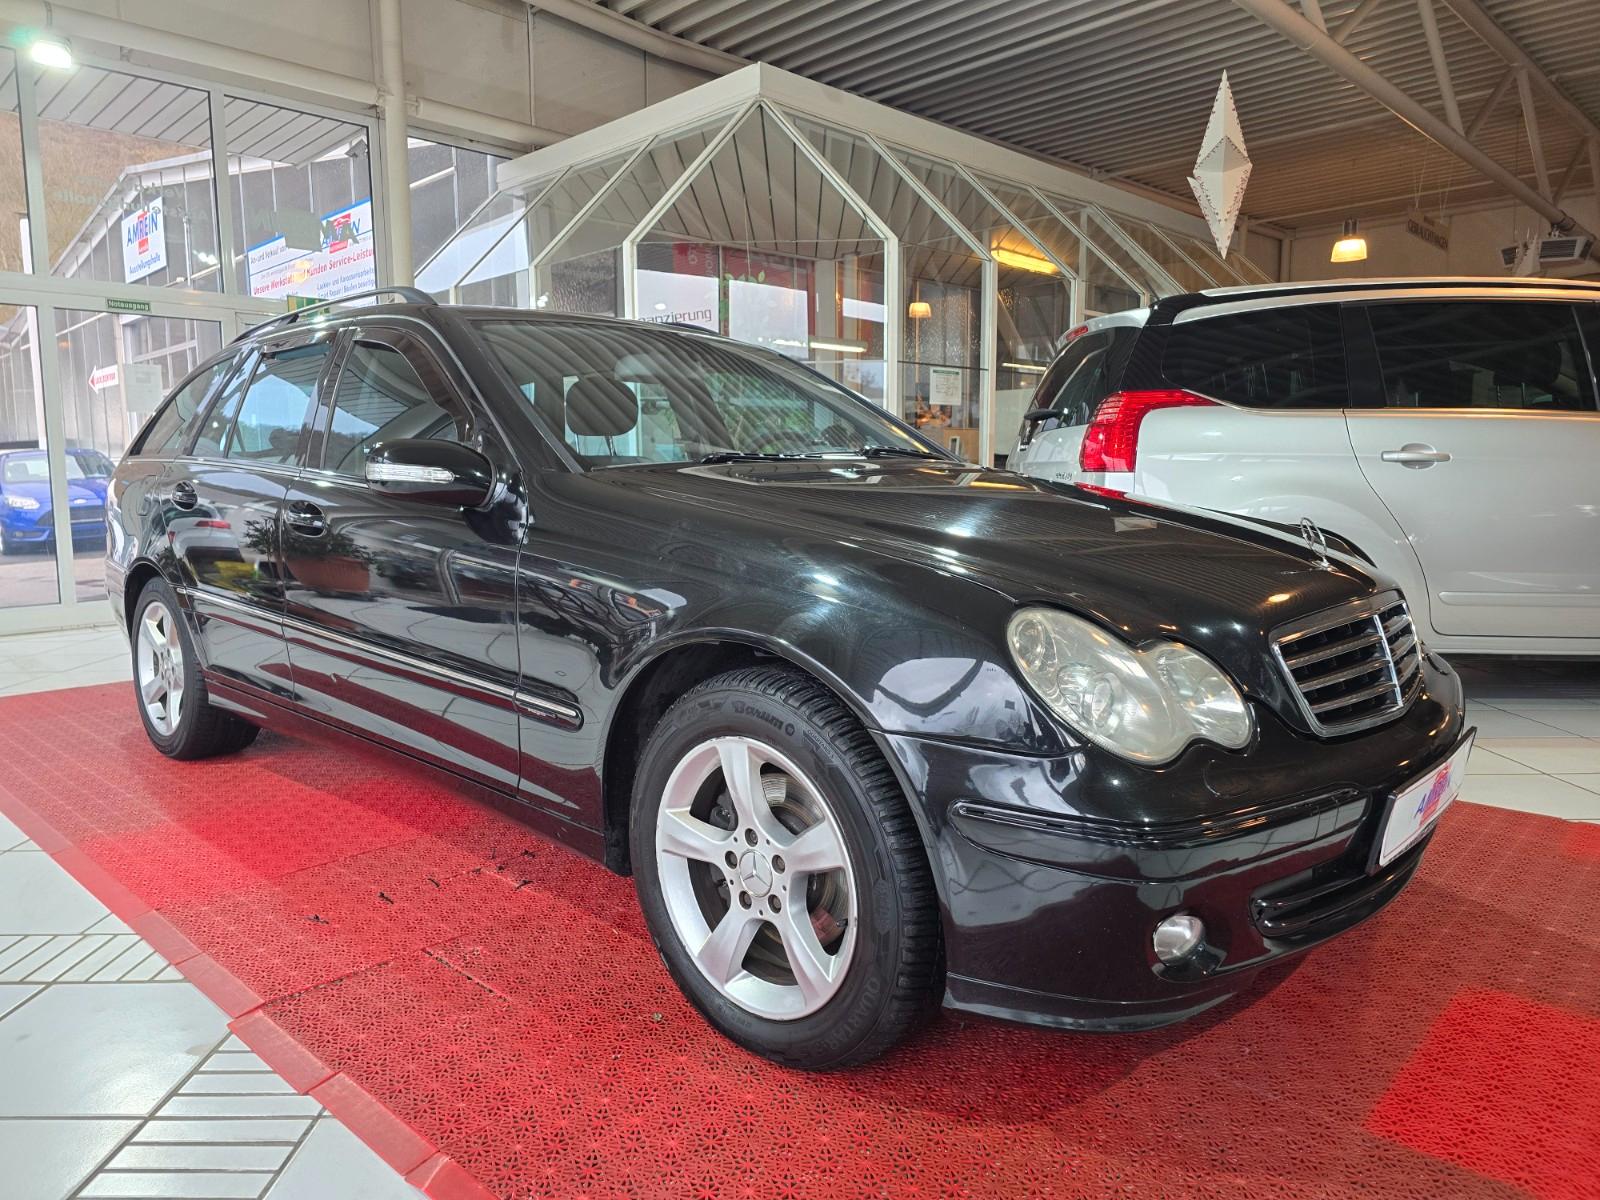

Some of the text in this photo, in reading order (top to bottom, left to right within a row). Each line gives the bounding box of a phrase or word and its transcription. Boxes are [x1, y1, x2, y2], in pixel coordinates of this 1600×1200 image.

[127, 212, 158, 247] AMREIN
[107, 300, 149, 311] Notausgang
[732, 701, 784, 730] Barum
